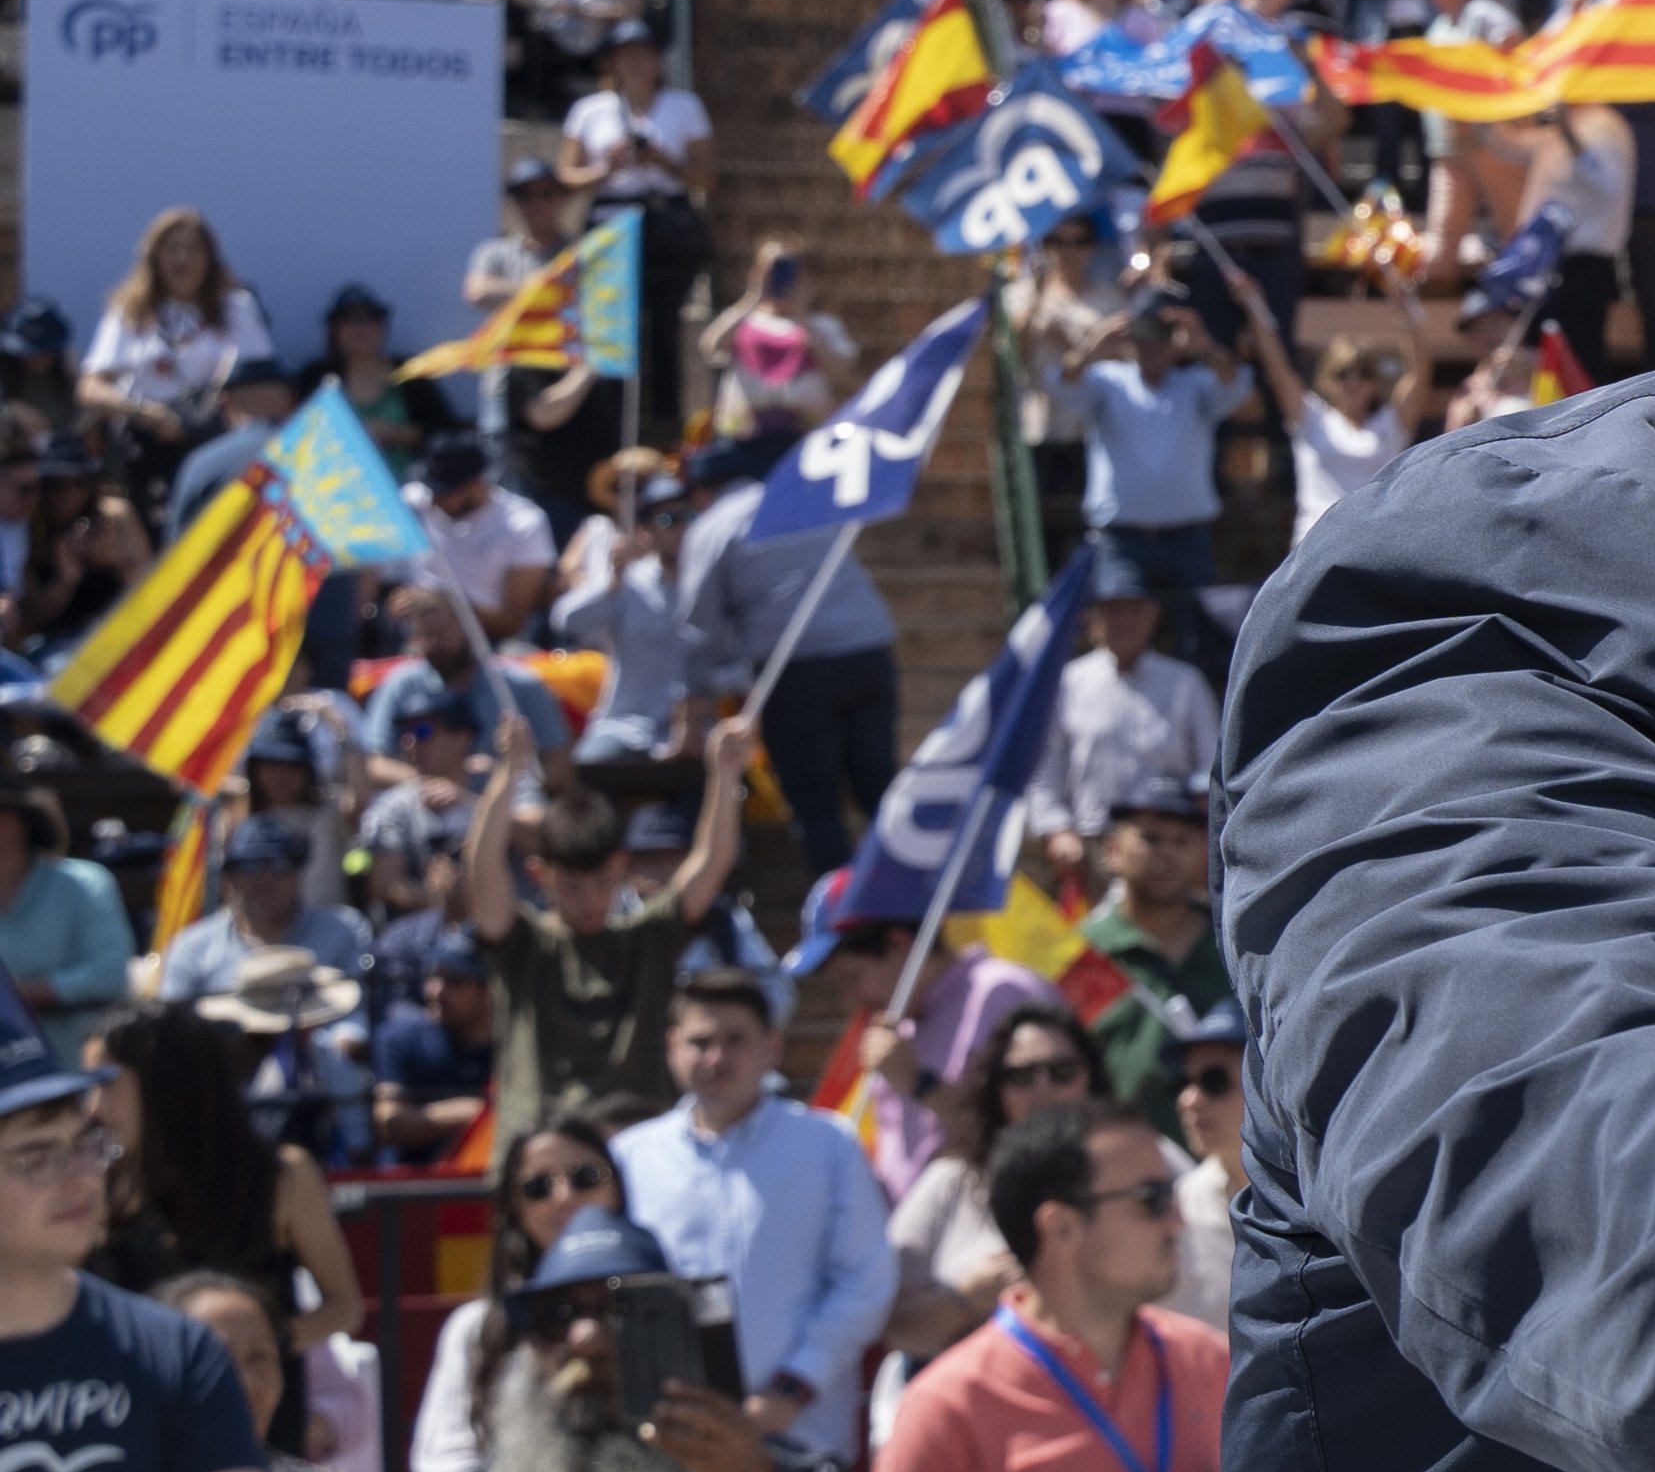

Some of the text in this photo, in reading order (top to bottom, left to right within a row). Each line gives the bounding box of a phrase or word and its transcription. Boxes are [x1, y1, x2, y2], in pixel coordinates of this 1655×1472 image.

[216, 2, 364, 38] ESPAÑA
[216, 39, 473, 83] ENTRE TODOS
[0, 1378, 132, 1439] QUIPO
